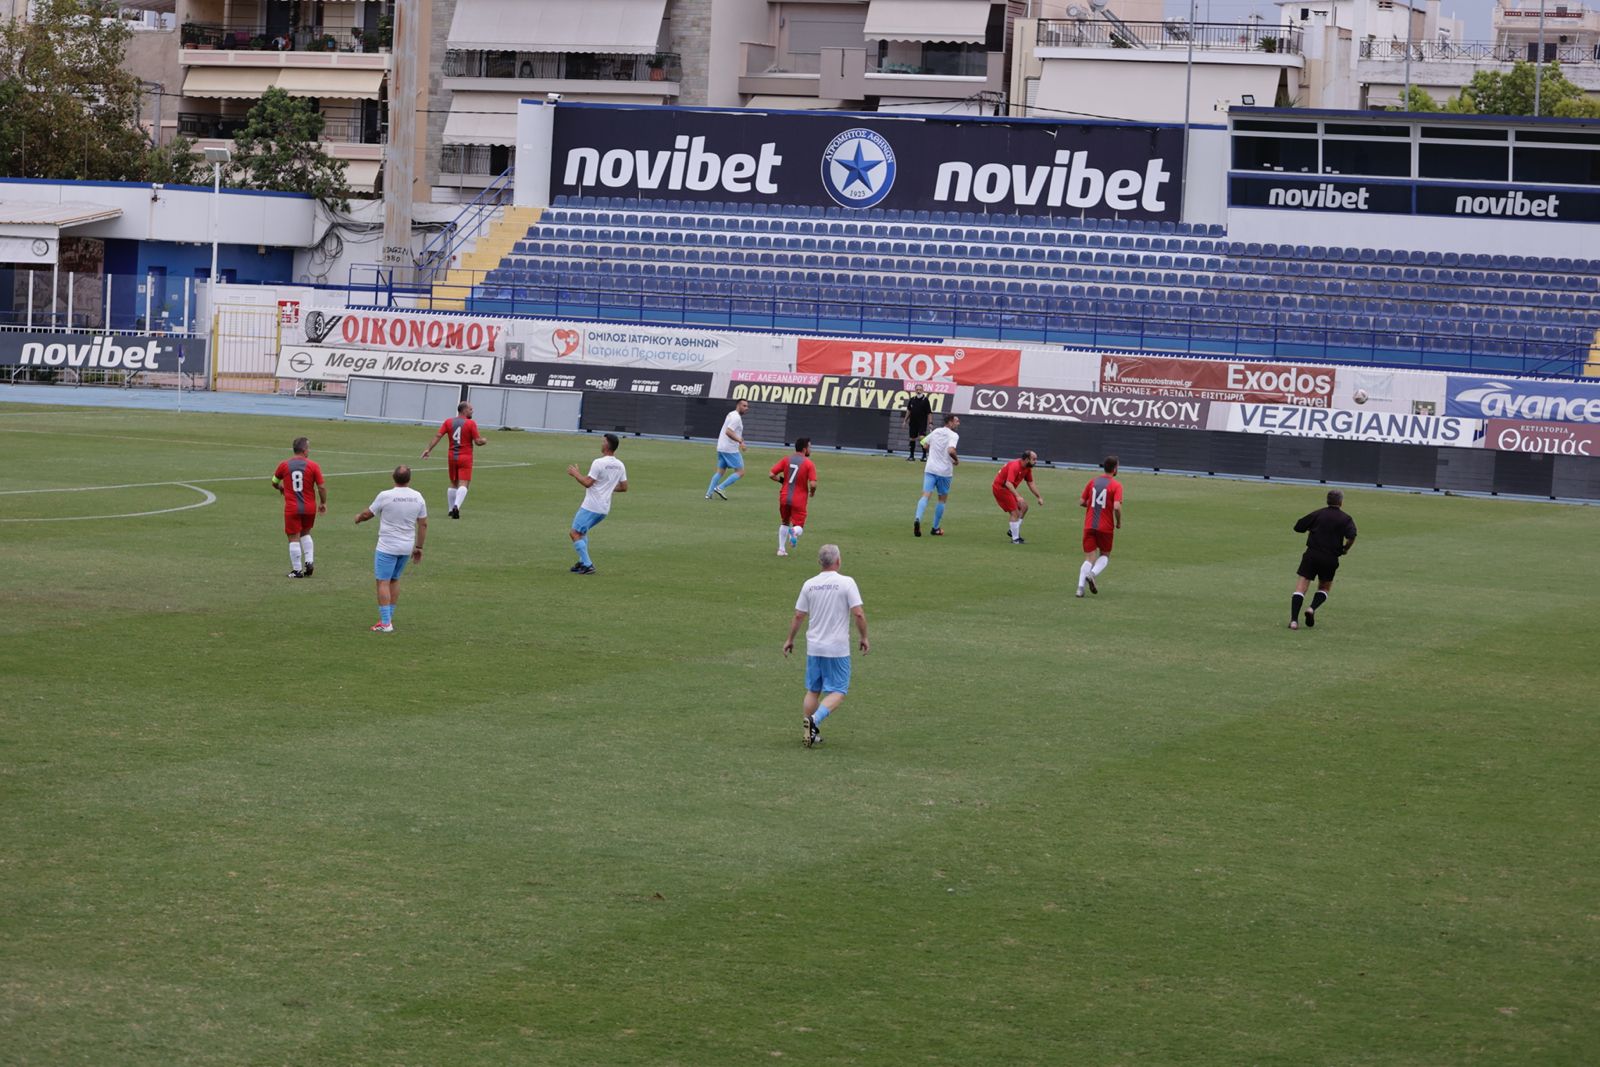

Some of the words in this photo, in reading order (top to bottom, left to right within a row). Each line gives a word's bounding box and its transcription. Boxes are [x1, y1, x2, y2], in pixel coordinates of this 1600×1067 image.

[867, 133, 894, 163] ΑΘΗΝΩΝ
[563, 135, 782, 194] novibet
[934, 150, 1170, 212] novibet
[850, 190, 866, 198] 1923
[1268, 183, 1369, 210] novibet
[1455, 191, 1560, 217] novibet
[342, 315, 502, 352] ΟΙΚΟΝΟΜΟΥ
[588, 331, 627, 343] ΟΜΙΛΟΣ
[628, 333, 674, 346] ΙΑΤΡΙΚΟΥ
[674, 336, 719, 348] ΑΘΗΝΩΝ
[20, 336, 162, 370] novibet
[588, 344, 629, 358] Ιατρικό
[631, 347, 705, 362] Περιστερίου
[325, 352, 377, 372] Mega
[383, 355, 450, 374] Motors
[454, 361, 486, 376] s.a.
[851, 350, 955, 382] ΒΙΚΟΣ
[505, 373, 536, 383] capelli
[585, 378, 618, 388] capelli
[671, 383, 703, 393] capelli
[757, 373, 808, 383] ΑΛΕΞΑΝΔΡΟΥ
[864, 379, 876, 388] τα
[1121, 376, 1193, 387] www.exodostravel.gr
[1227, 363, 1332, 395] Exodos
[1102, 385, 1150, 396] ΕΚΔΡΟΜΕΣ
[1158, 388, 1193, 398] ΤΑΞΙΔΙΑ
[1201, 391, 1245, 402] ΕΙΣΙΤΗΡΙΑ
[1284, 393, 1328, 408] Travel
[1240, 404, 1461, 441] VEZIRGIANNIS
[1520, 425, 1569, 434] ΕΣΤΙΑΤΟΡΙΑ
[452, 426, 462, 444] 4
[291, 470, 304, 492] 8
[789, 463, 799, 484] 7
[1091, 487, 1108, 509] 14
